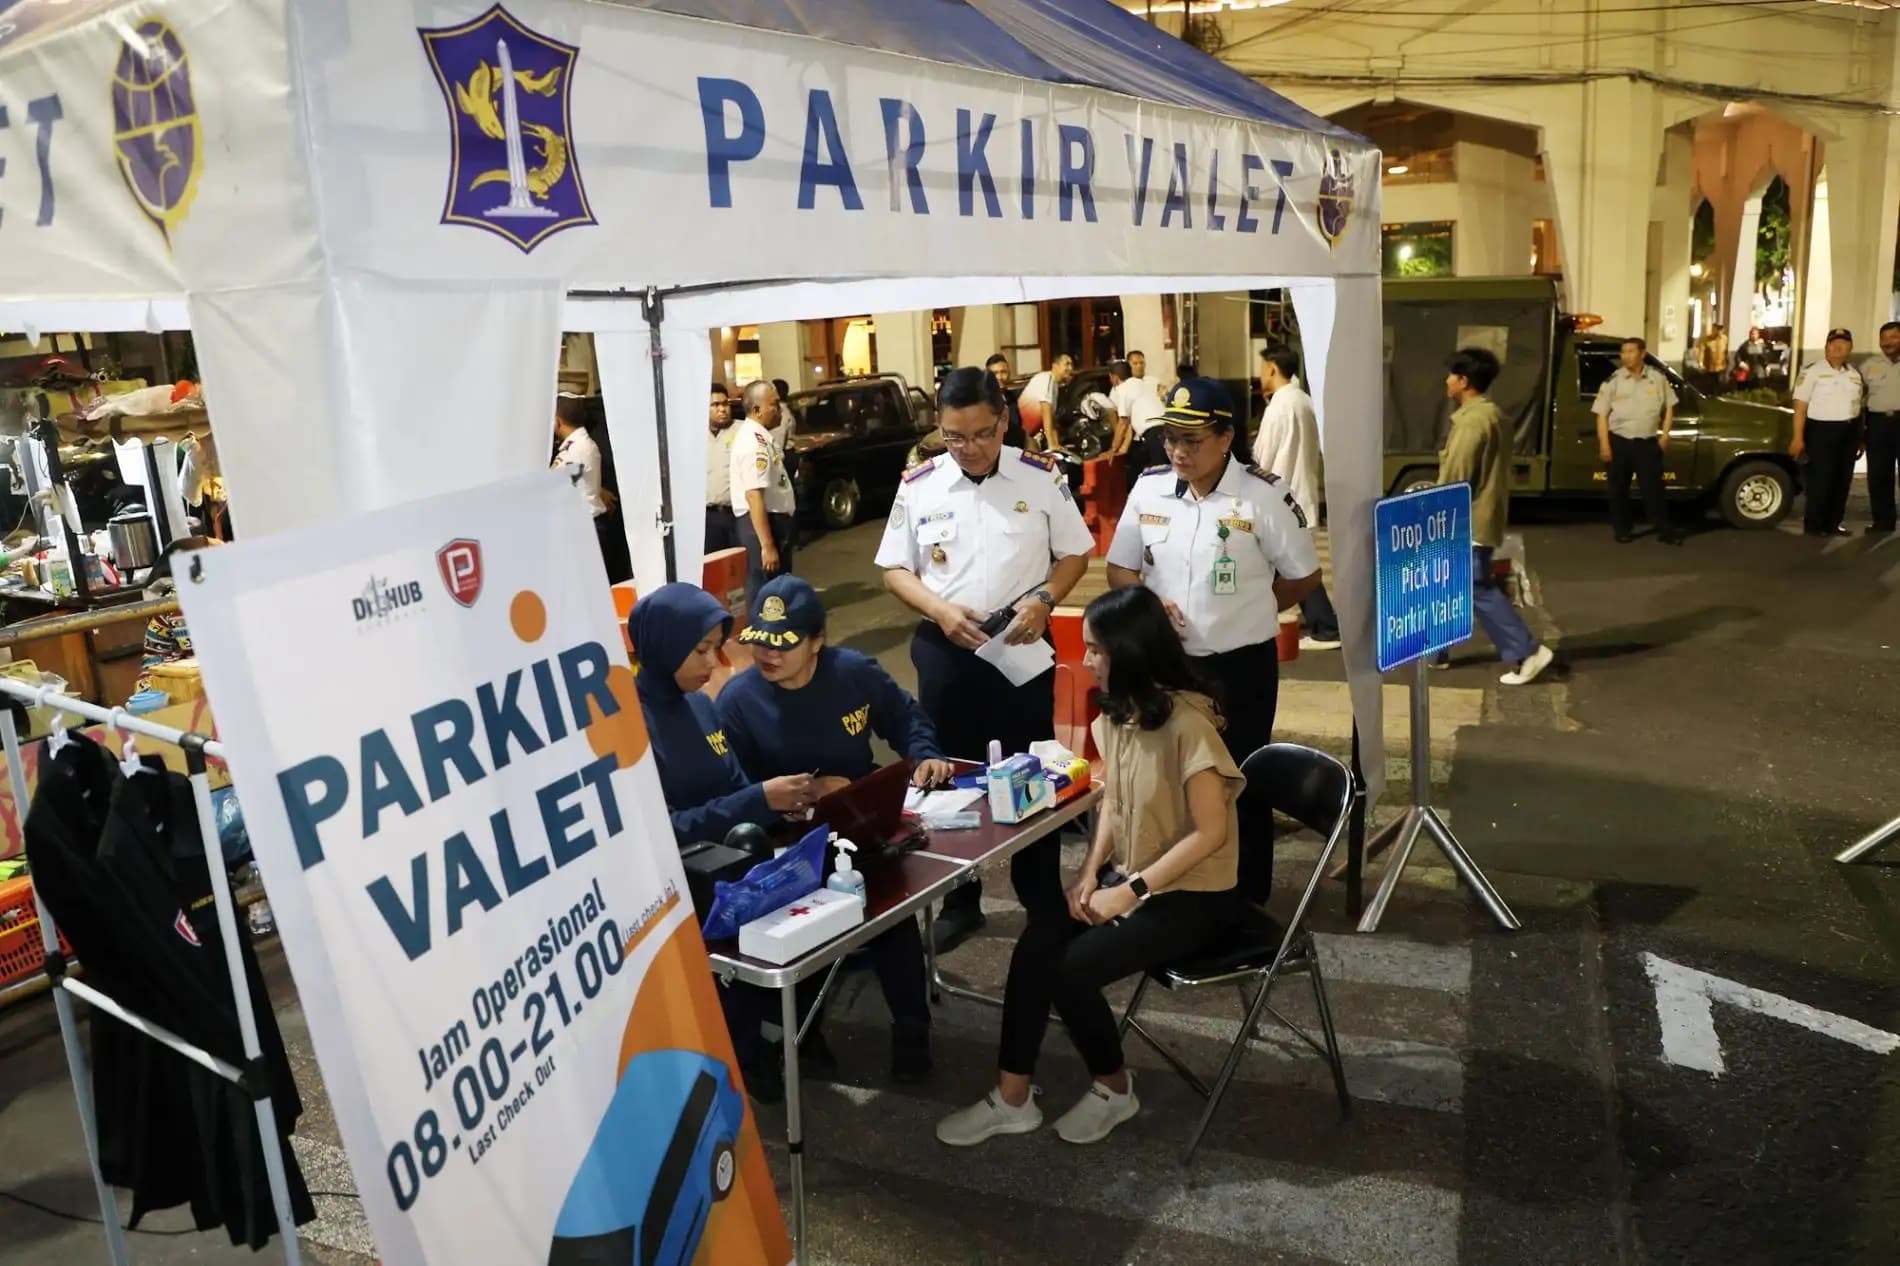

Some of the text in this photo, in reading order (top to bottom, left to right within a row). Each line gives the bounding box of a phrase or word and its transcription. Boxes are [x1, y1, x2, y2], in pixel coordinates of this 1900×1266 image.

[697, 76, 1293, 235] PARKIR VALET
[1391, 523, 1423, 553] Drop
[1427, 511, 1447, 543] Off
[1402, 558, 1450, 594] Pick Up
[1387, 590, 1464, 645] Parkir Valet
[276, 641, 621, 871] PARKIR
[366, 753, 624, 962] VALET
[418, 877, 607, 1091] Jam Operasional
[386, 918, 625, 1213] 08.00-21.00
[468, 1055, 557, 1166] Last Check Out
